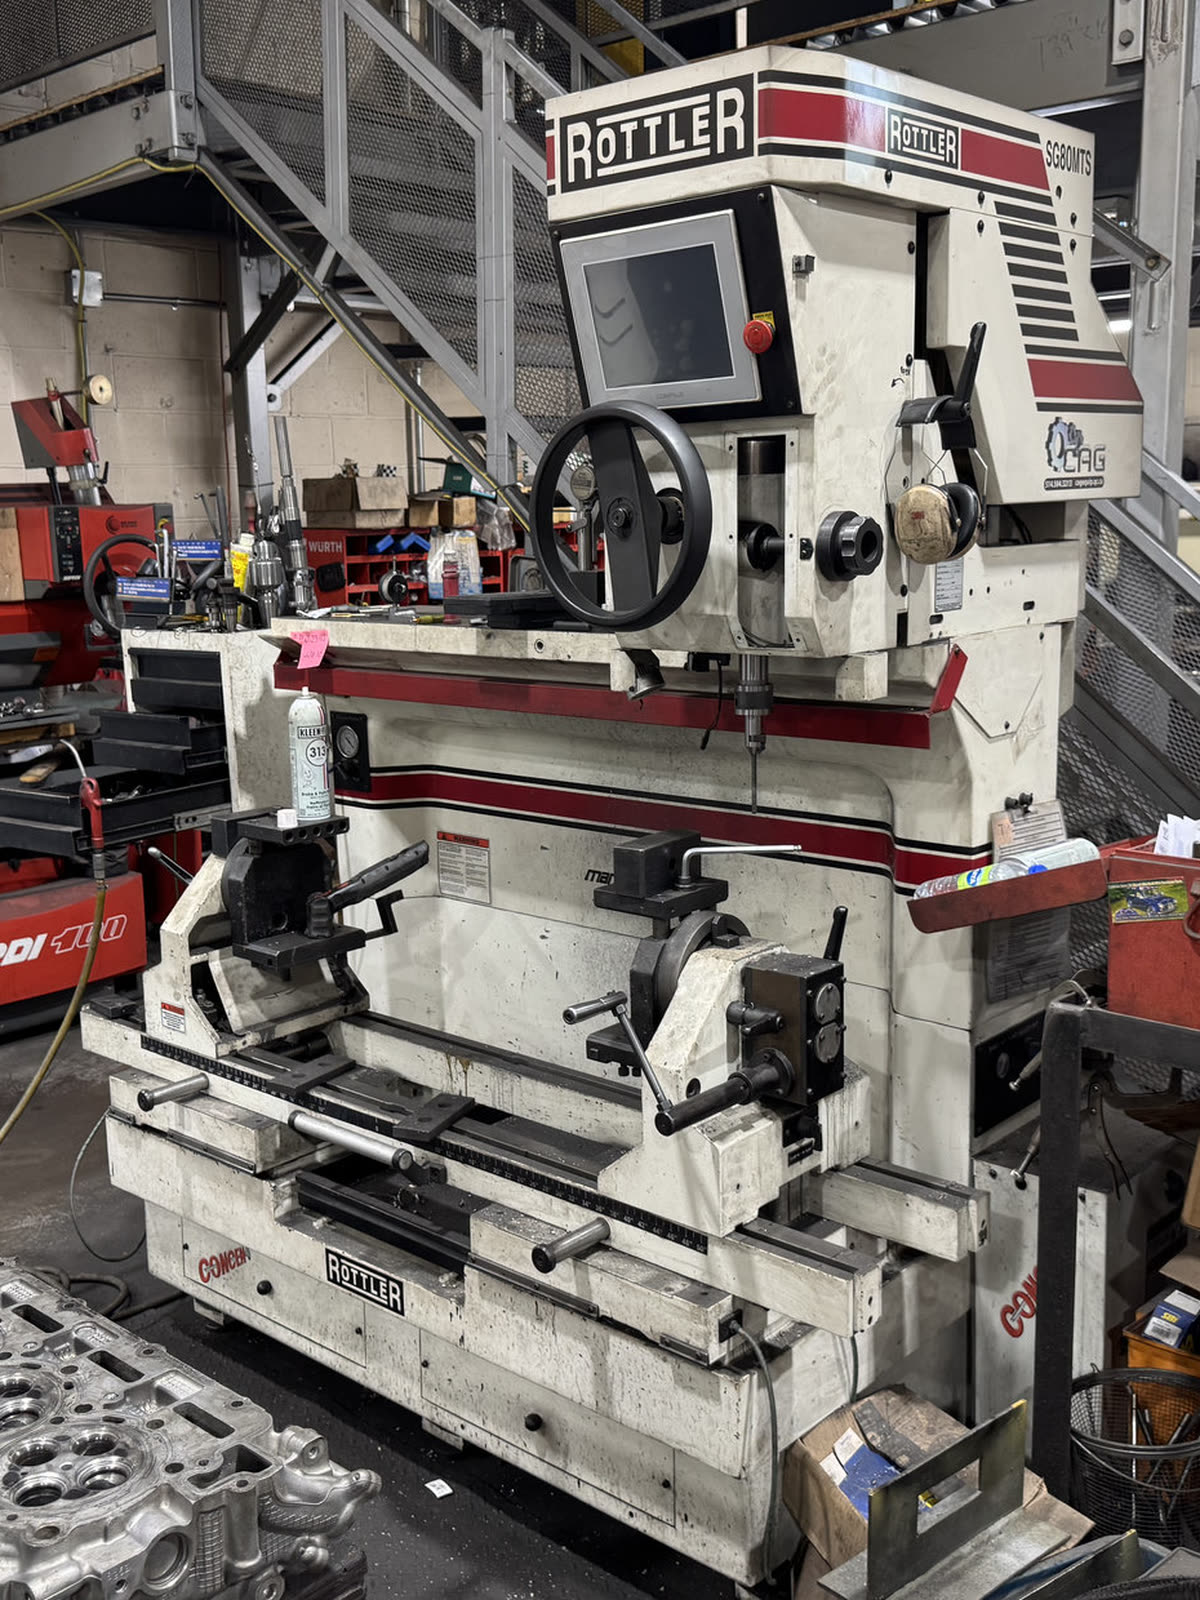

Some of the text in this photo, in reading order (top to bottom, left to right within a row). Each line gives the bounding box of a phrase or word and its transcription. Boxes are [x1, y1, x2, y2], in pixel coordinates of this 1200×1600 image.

[566, 87, 746, 184] ROTTLER
[889, 113, 957, 166] ROTTLER
[1045, 140, 1093, 177] SG80MTS
[327, 1252, 401, 1312] ROTTLER
